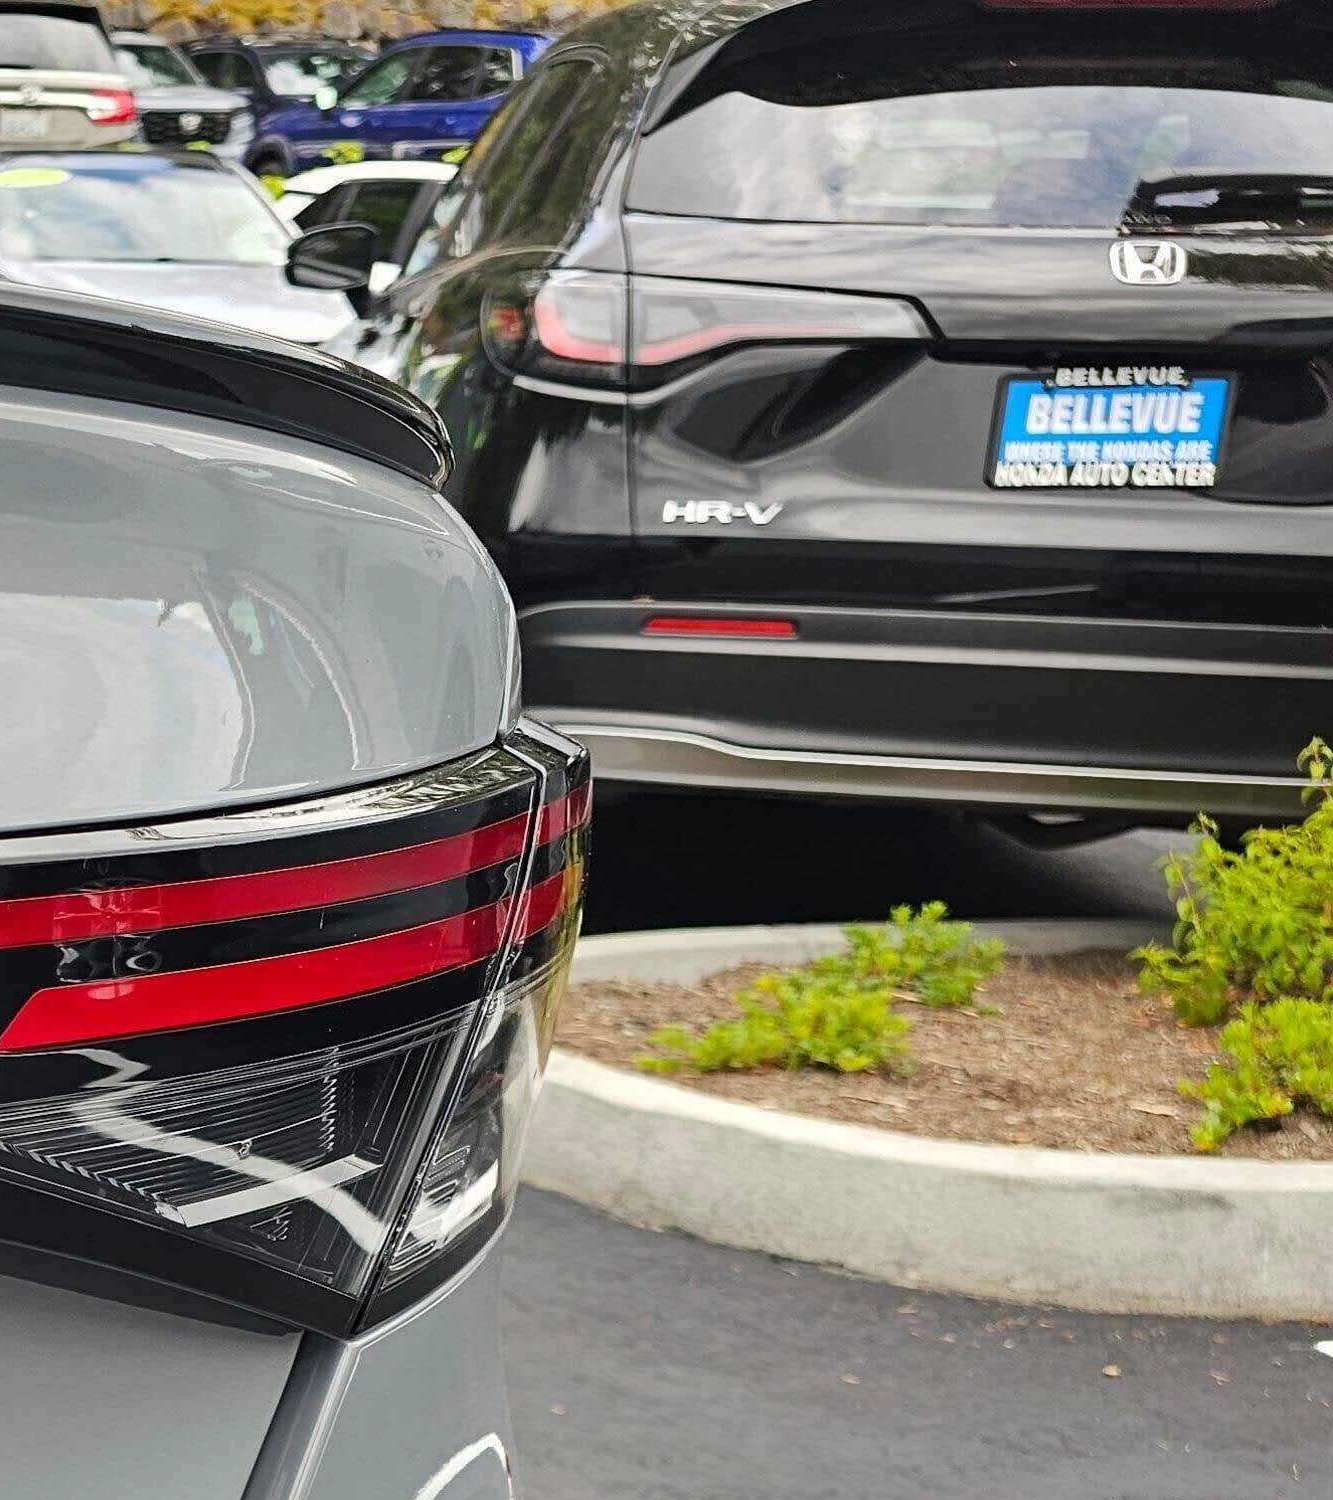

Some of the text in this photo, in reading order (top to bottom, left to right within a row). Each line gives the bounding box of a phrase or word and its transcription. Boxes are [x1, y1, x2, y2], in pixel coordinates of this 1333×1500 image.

[1054, 366, 1186, 387] BELLEVUE
[1026, 391, 1205, 434] BELLEVUE
[1069, 462, 1129, 486] AUTO
[1131, 461, 1216, 487] CENTER
[662, 500, 784, 525] HR-V
